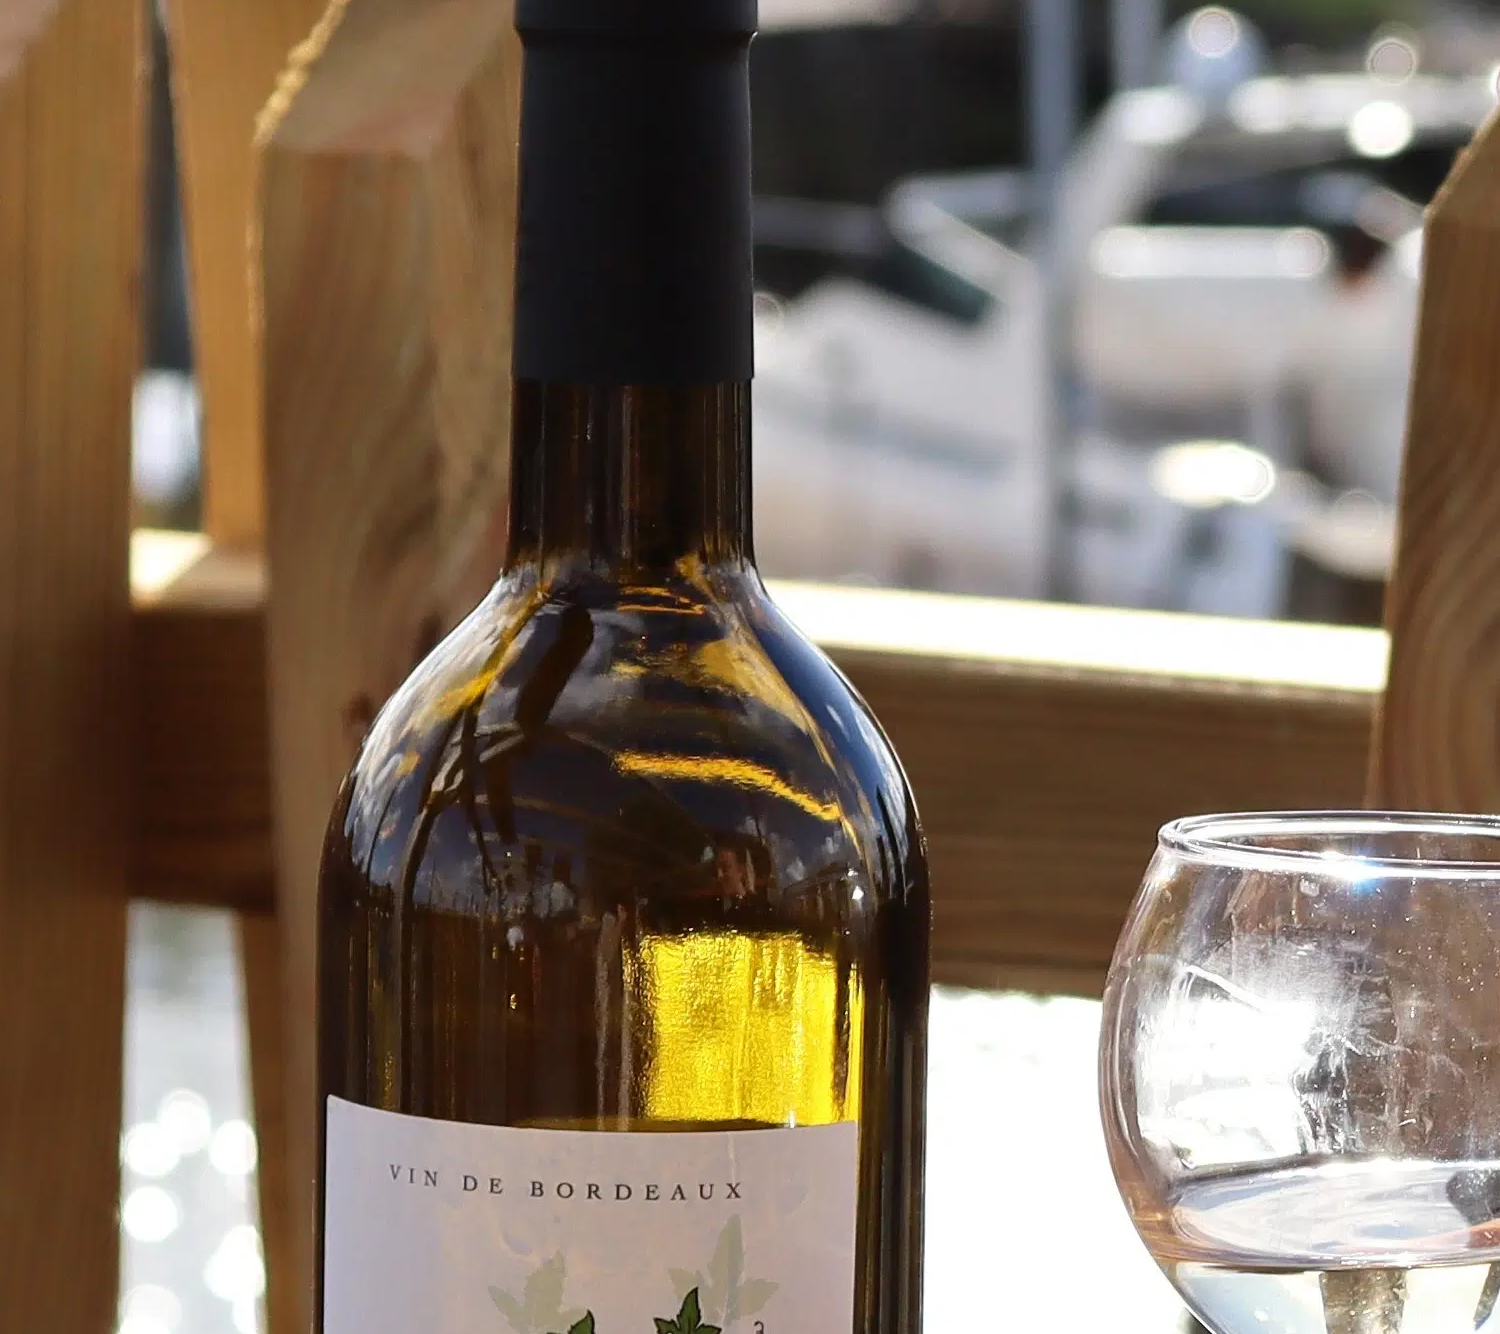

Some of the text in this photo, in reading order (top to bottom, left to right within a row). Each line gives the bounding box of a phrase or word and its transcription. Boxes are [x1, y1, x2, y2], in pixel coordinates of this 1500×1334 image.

[389, 1163, 742, 1201] VIN DE BORDEAUX
